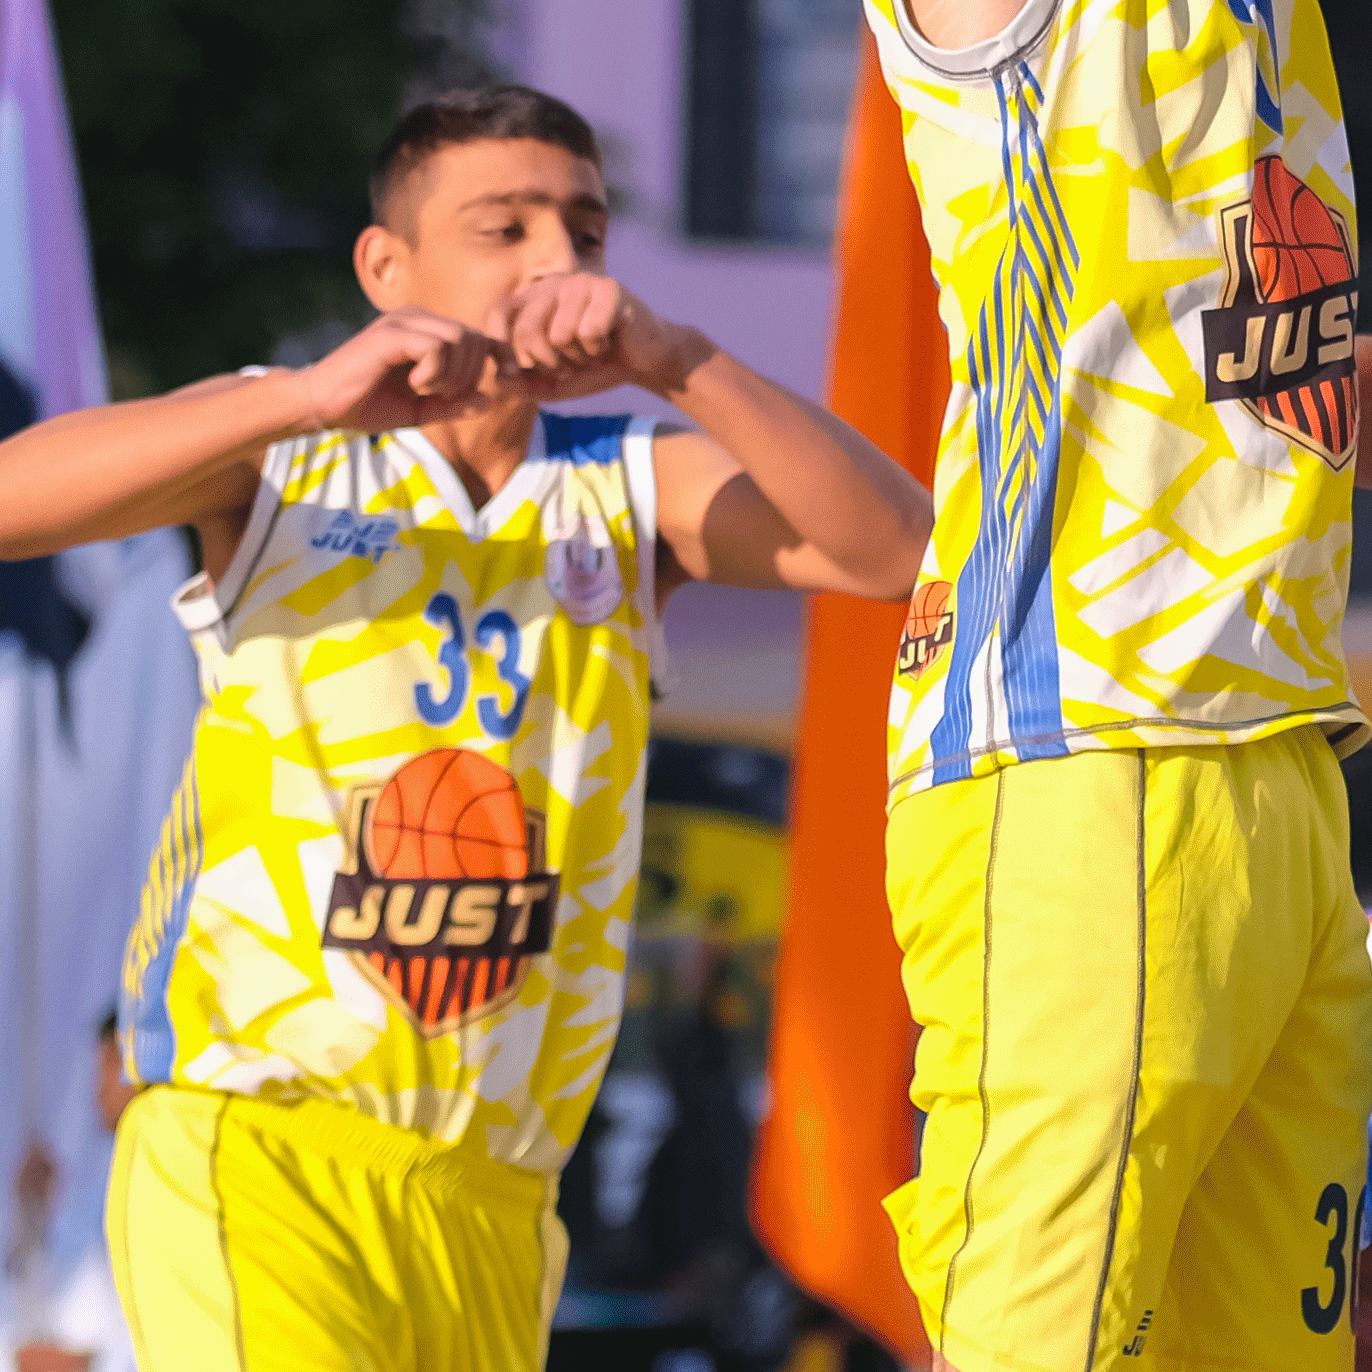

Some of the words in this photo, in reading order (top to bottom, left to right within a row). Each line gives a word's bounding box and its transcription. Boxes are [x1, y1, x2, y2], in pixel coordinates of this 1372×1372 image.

[1216, 291, 1358, 383] JUS
[414, 592, 530, 740] 33
[330, 884, 548, 948] JUST
[1301, 1182, 1366, 1336] 3
